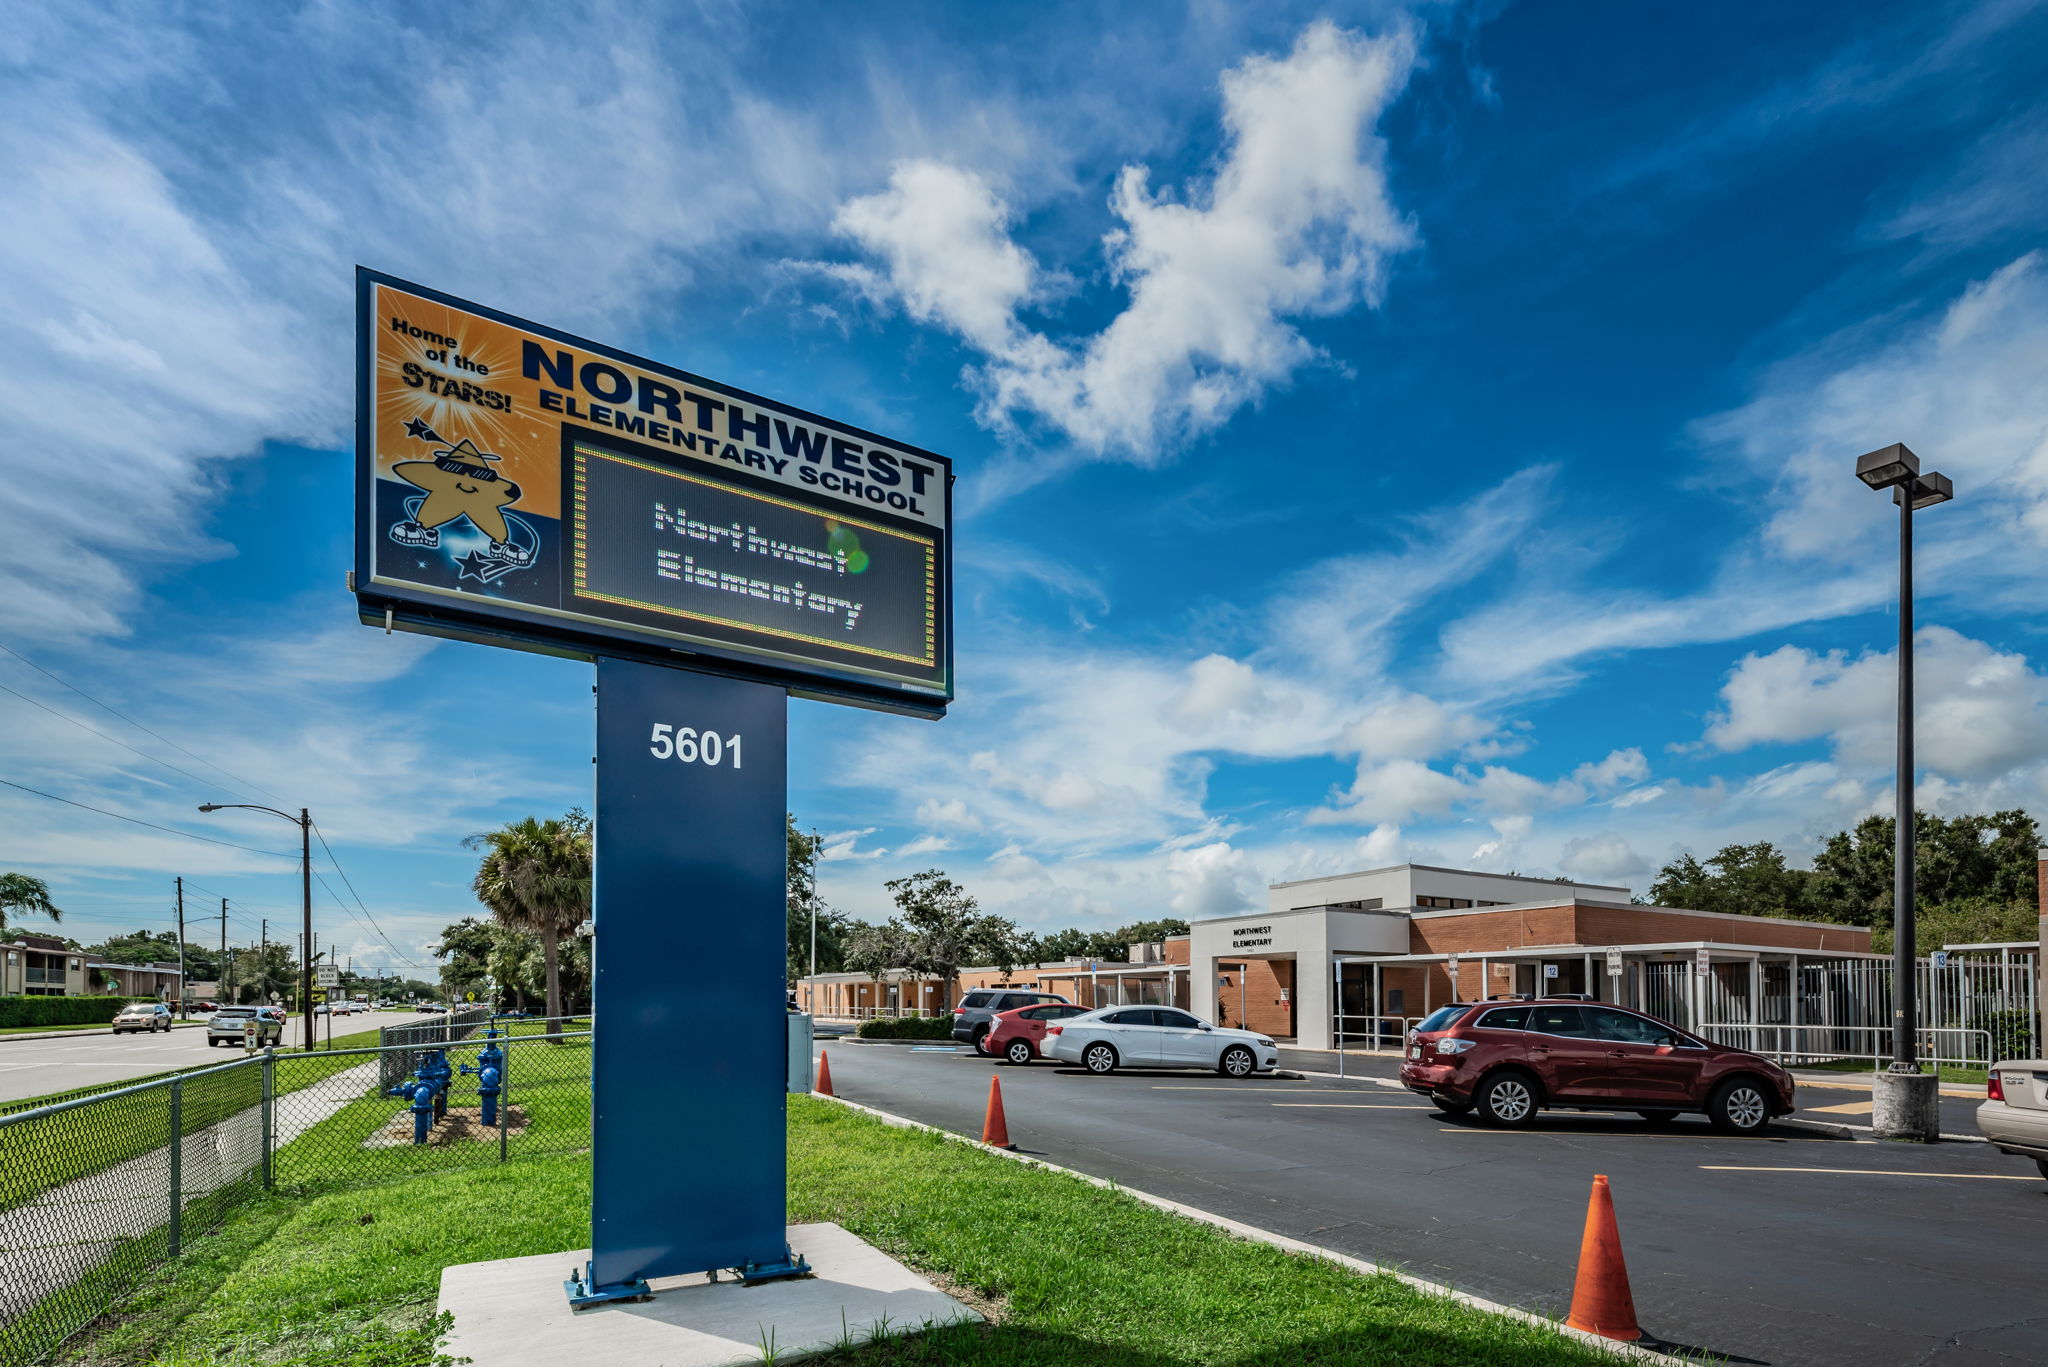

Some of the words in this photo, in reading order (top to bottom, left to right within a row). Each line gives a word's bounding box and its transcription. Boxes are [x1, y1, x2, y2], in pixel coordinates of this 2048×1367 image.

[392, 317, 457, 348] Home
[426, 349, 447, 363] of
[454, 354, 489, 375] the
[402, 362, 511, 414] STARS!
[523, 339, 935, 496] NORTHWEST
[539, 388, 789, 476] ELEMENTARY
[799, 465, 925, 516] SCHOOL
[655, 502, 848, 577] Northwest
[657, 549, 863, 630] Elementary
[650, 722, 741, 769] 5601
[1232, 938, 1272, 948] ELEMENTARY
[1233, 925, 1272, 936] NORTHWEST
[1548, 967, 1556, 975] 12
[1937, 954, 1946, 966] 13
